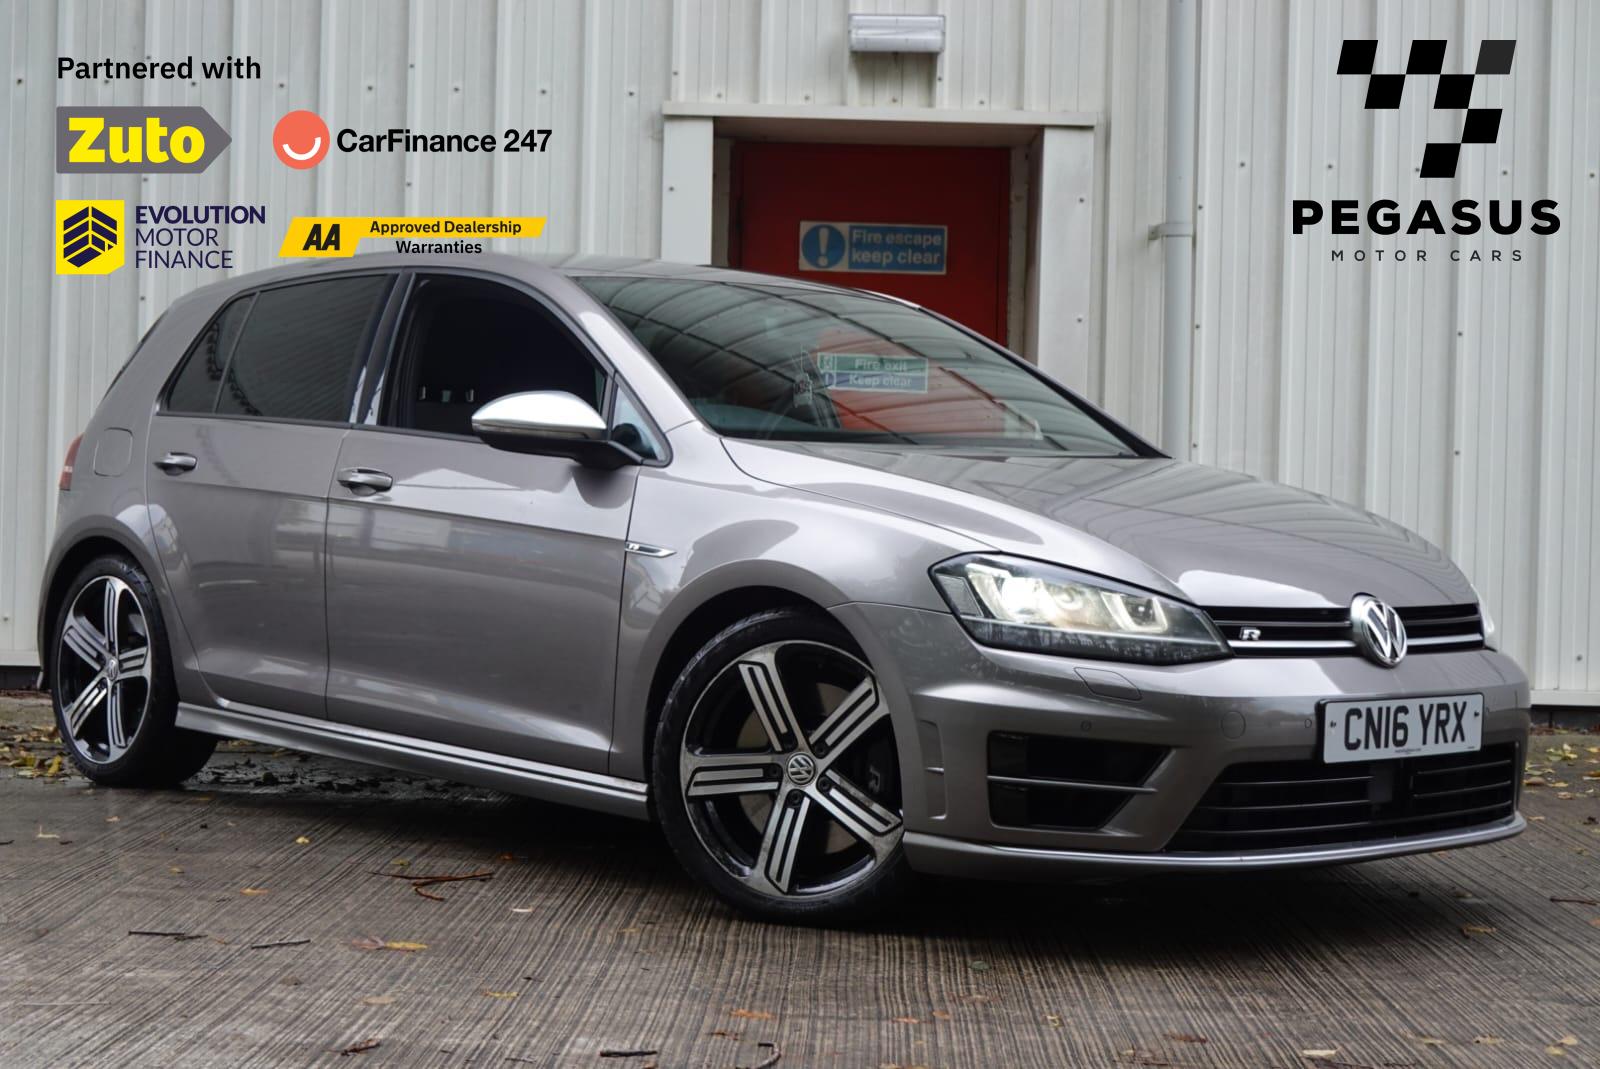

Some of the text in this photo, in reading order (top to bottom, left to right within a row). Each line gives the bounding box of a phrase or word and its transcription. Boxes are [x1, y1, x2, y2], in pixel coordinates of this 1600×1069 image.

[852, 229, 942, 248] Fire escape
[852, 250, 941, 267] keep clear
[855, 359, 908, 371] Fire exit
[849, 374, 881, 388] Keep
[1239, 626, 1261, 641] R
[1344, 700, 1468, 751] CN16 YRX
